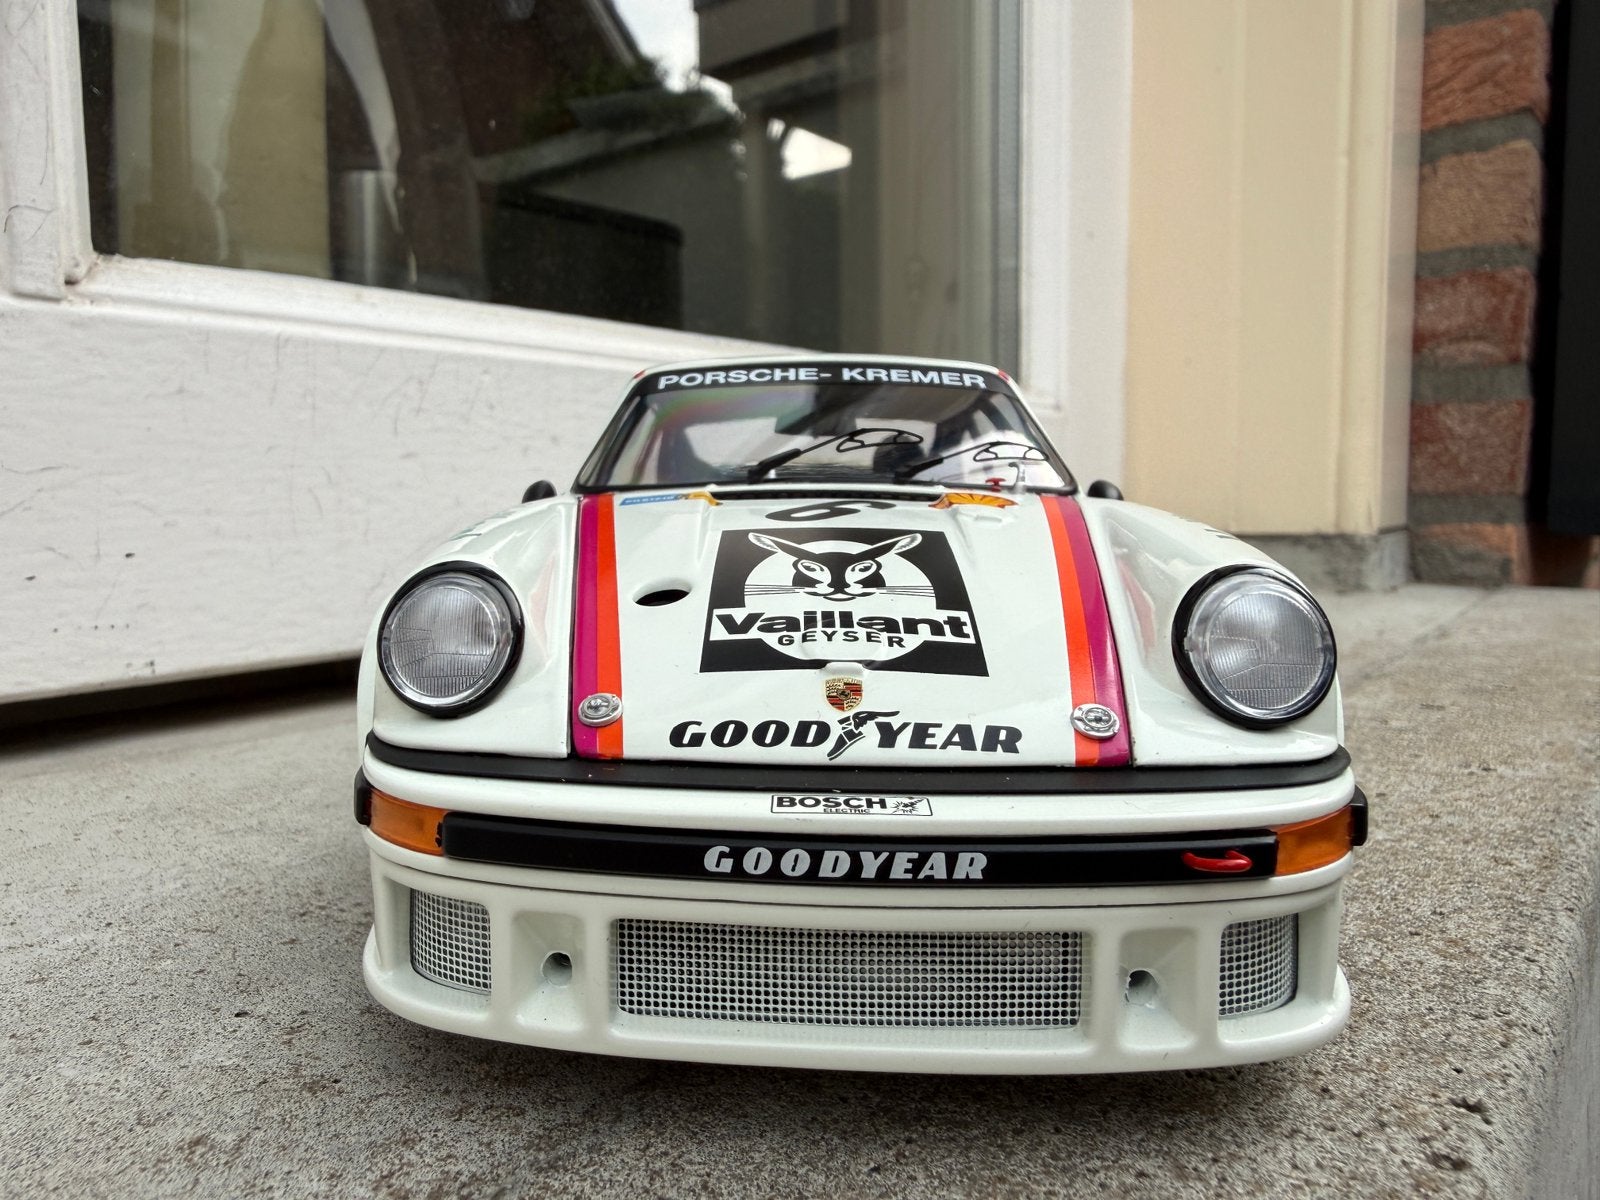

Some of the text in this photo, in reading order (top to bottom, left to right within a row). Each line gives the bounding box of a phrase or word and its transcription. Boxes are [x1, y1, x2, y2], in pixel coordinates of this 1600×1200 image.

[657, 367, 986, 389] PORSCHE- KREMER
[765, 500, 896, 521] 6
[715, 610, 971, 639] Vaillant
[777, 630, 906, 648] GEYSER
[776, 796, 887, 809] BOSCH
[703, 845, 988, 880] GOODYEAR
